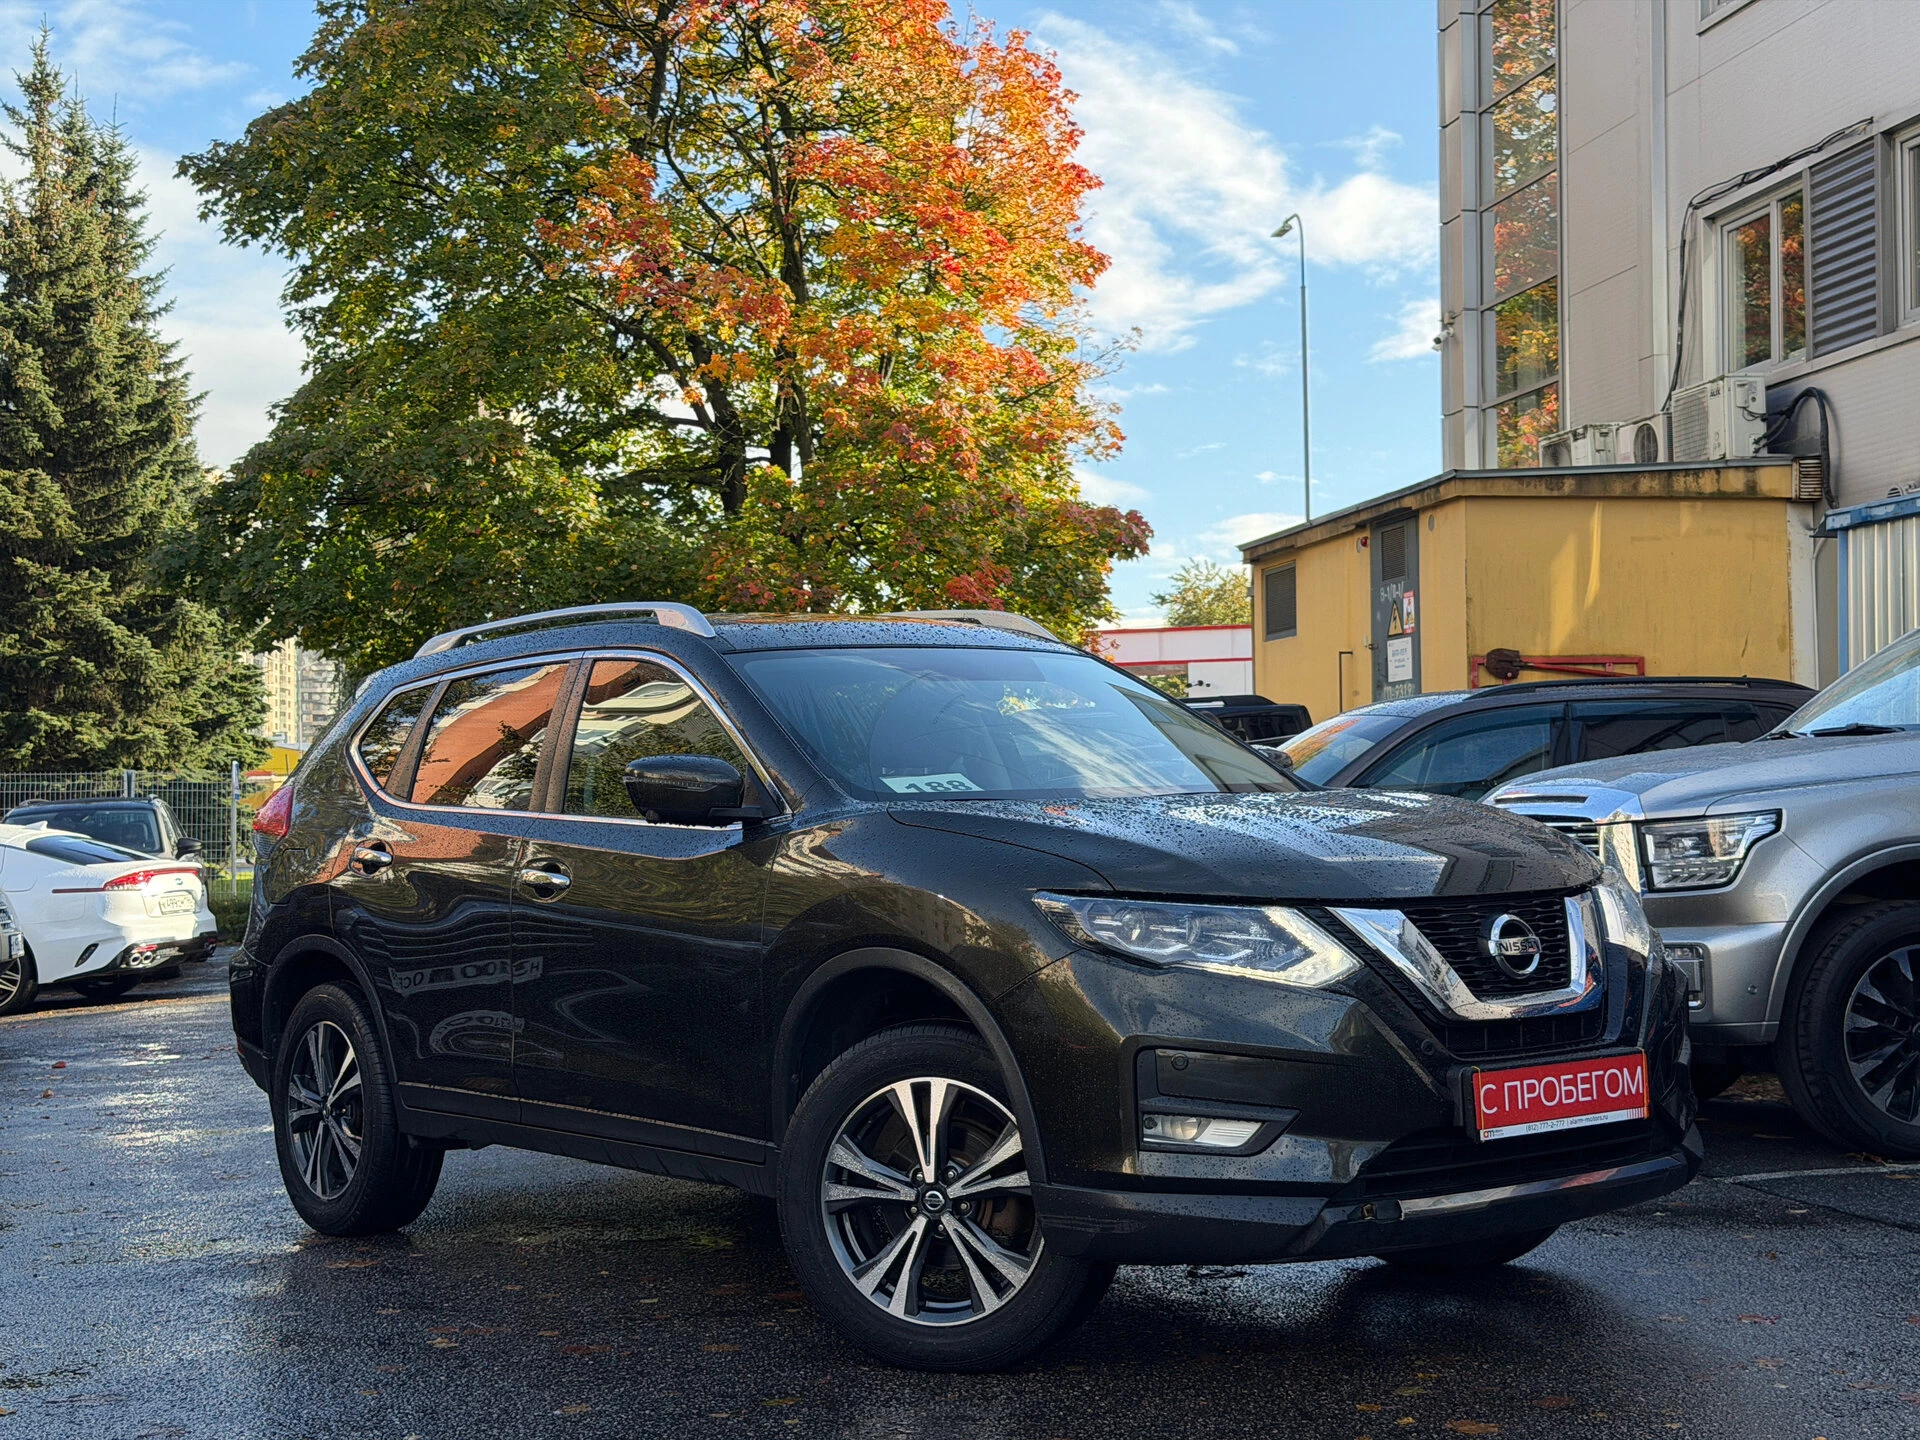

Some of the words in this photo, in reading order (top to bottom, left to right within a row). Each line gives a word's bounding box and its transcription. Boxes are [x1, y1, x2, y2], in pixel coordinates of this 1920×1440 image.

[904, 779, 973, 793] 188
[1480, 1083, 1498, 1115] С
[1504, 1065, 1643, 1112] ПРОБЕГОМ
